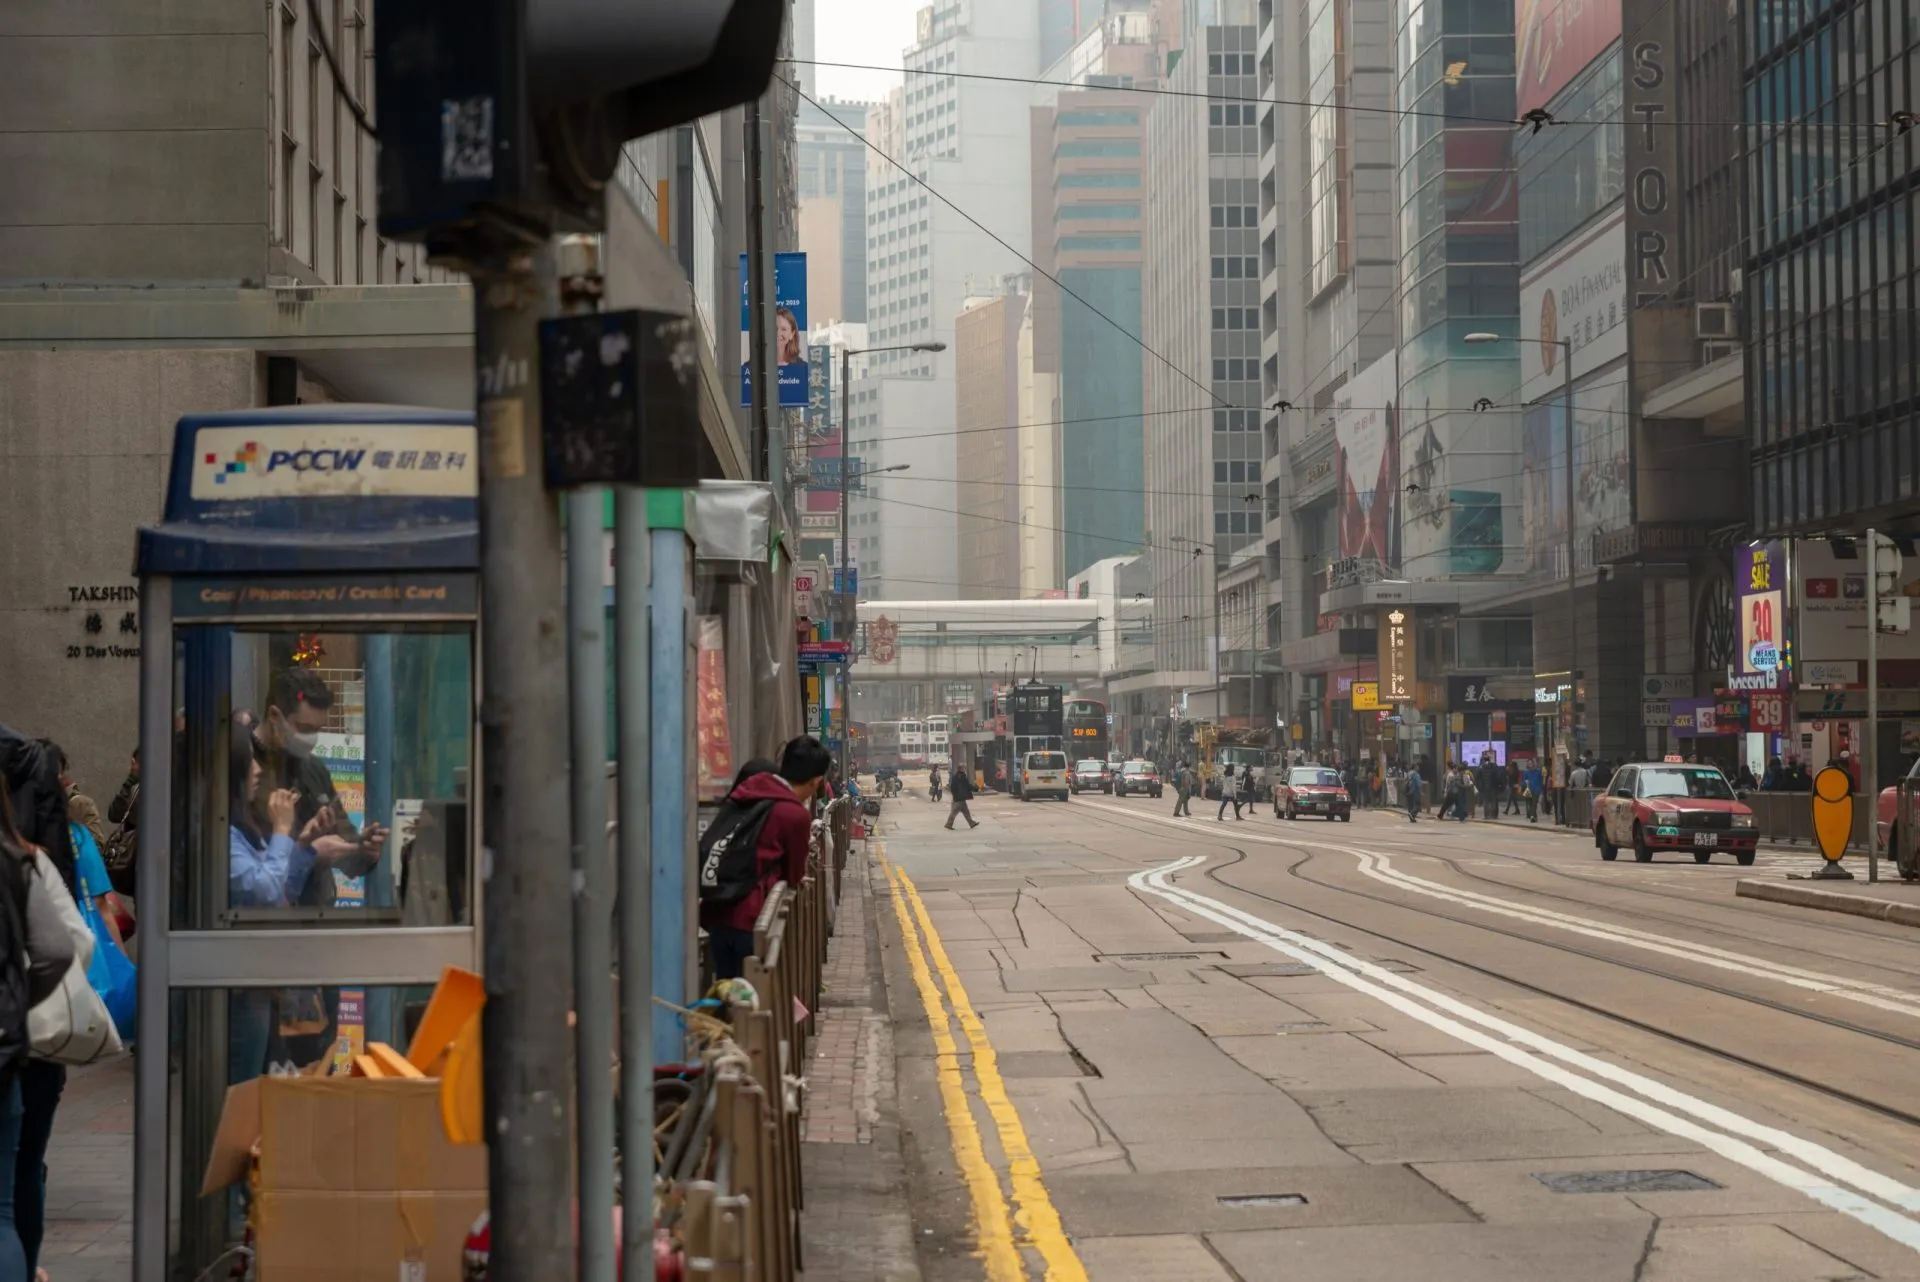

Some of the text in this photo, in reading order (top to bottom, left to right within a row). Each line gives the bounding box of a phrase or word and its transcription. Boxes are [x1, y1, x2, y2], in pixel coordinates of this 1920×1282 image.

[1633, 42, 1668, 308] STOR
[267, 449, 467, 472] PCCW 電訊盈科
[1751, 563, 1770, 590] SALE
[200, 588, 234, 602] Coin
[349, 586, 400, 600] Credit
[405, 586, 446, 600] Card
[67, 645, 81, 658] 20
[85, 646, 107, 658] Des
[1753, 656, 1778, 666] SERVICE
[1755, 648, 1776, 658] MEANS
[1756, 699, 1783, 725] 39
